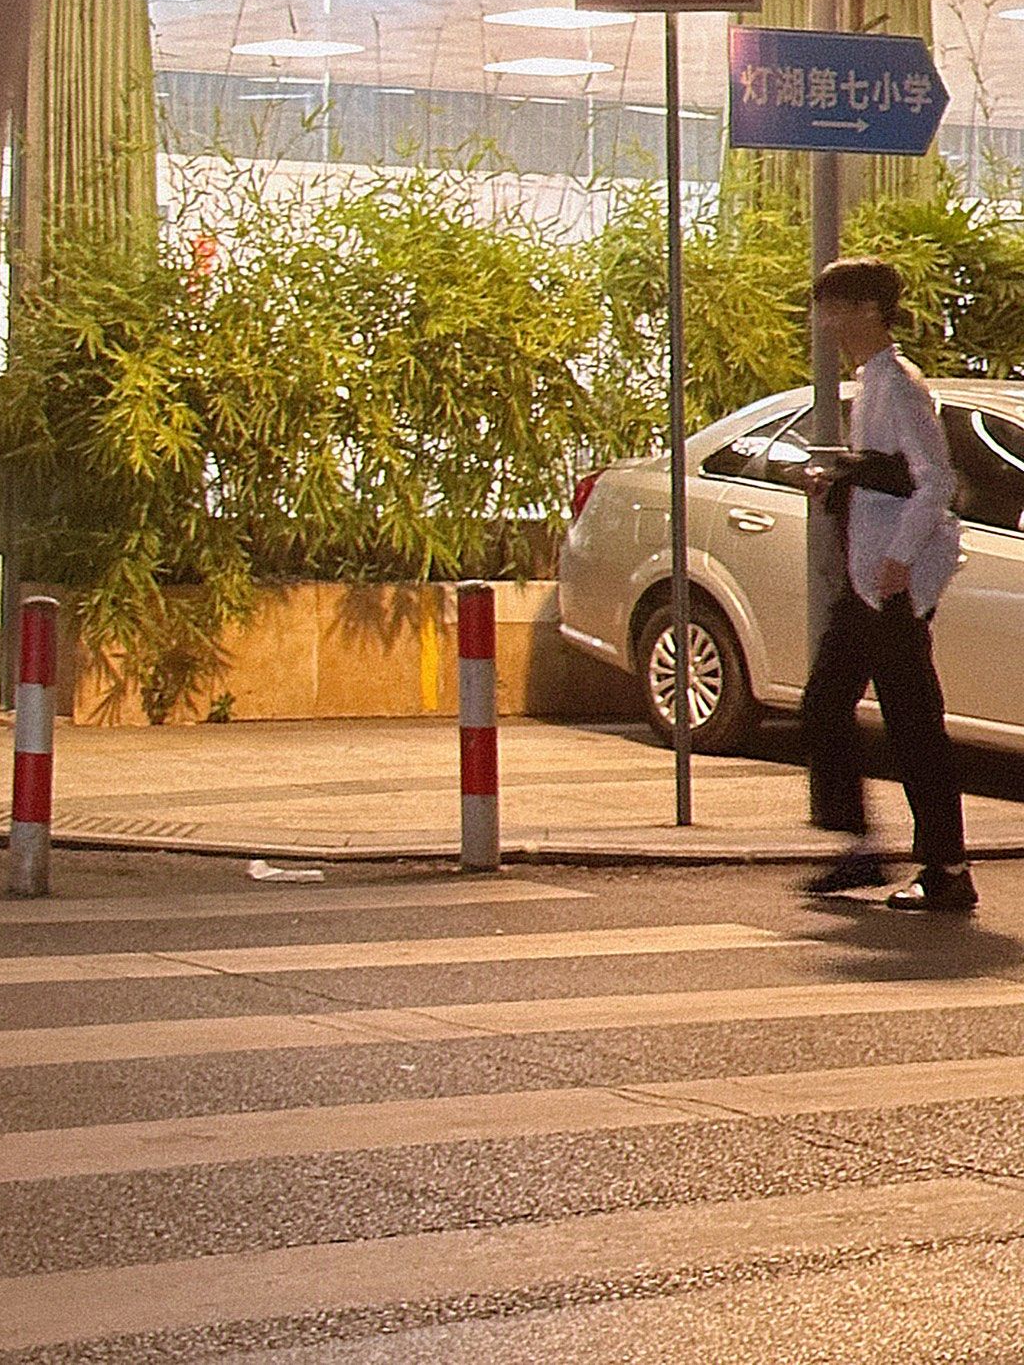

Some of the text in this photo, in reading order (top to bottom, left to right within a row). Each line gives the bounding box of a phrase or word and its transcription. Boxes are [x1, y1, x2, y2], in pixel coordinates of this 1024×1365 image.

[740, 64, 934, 114] 灯湖第七小学
